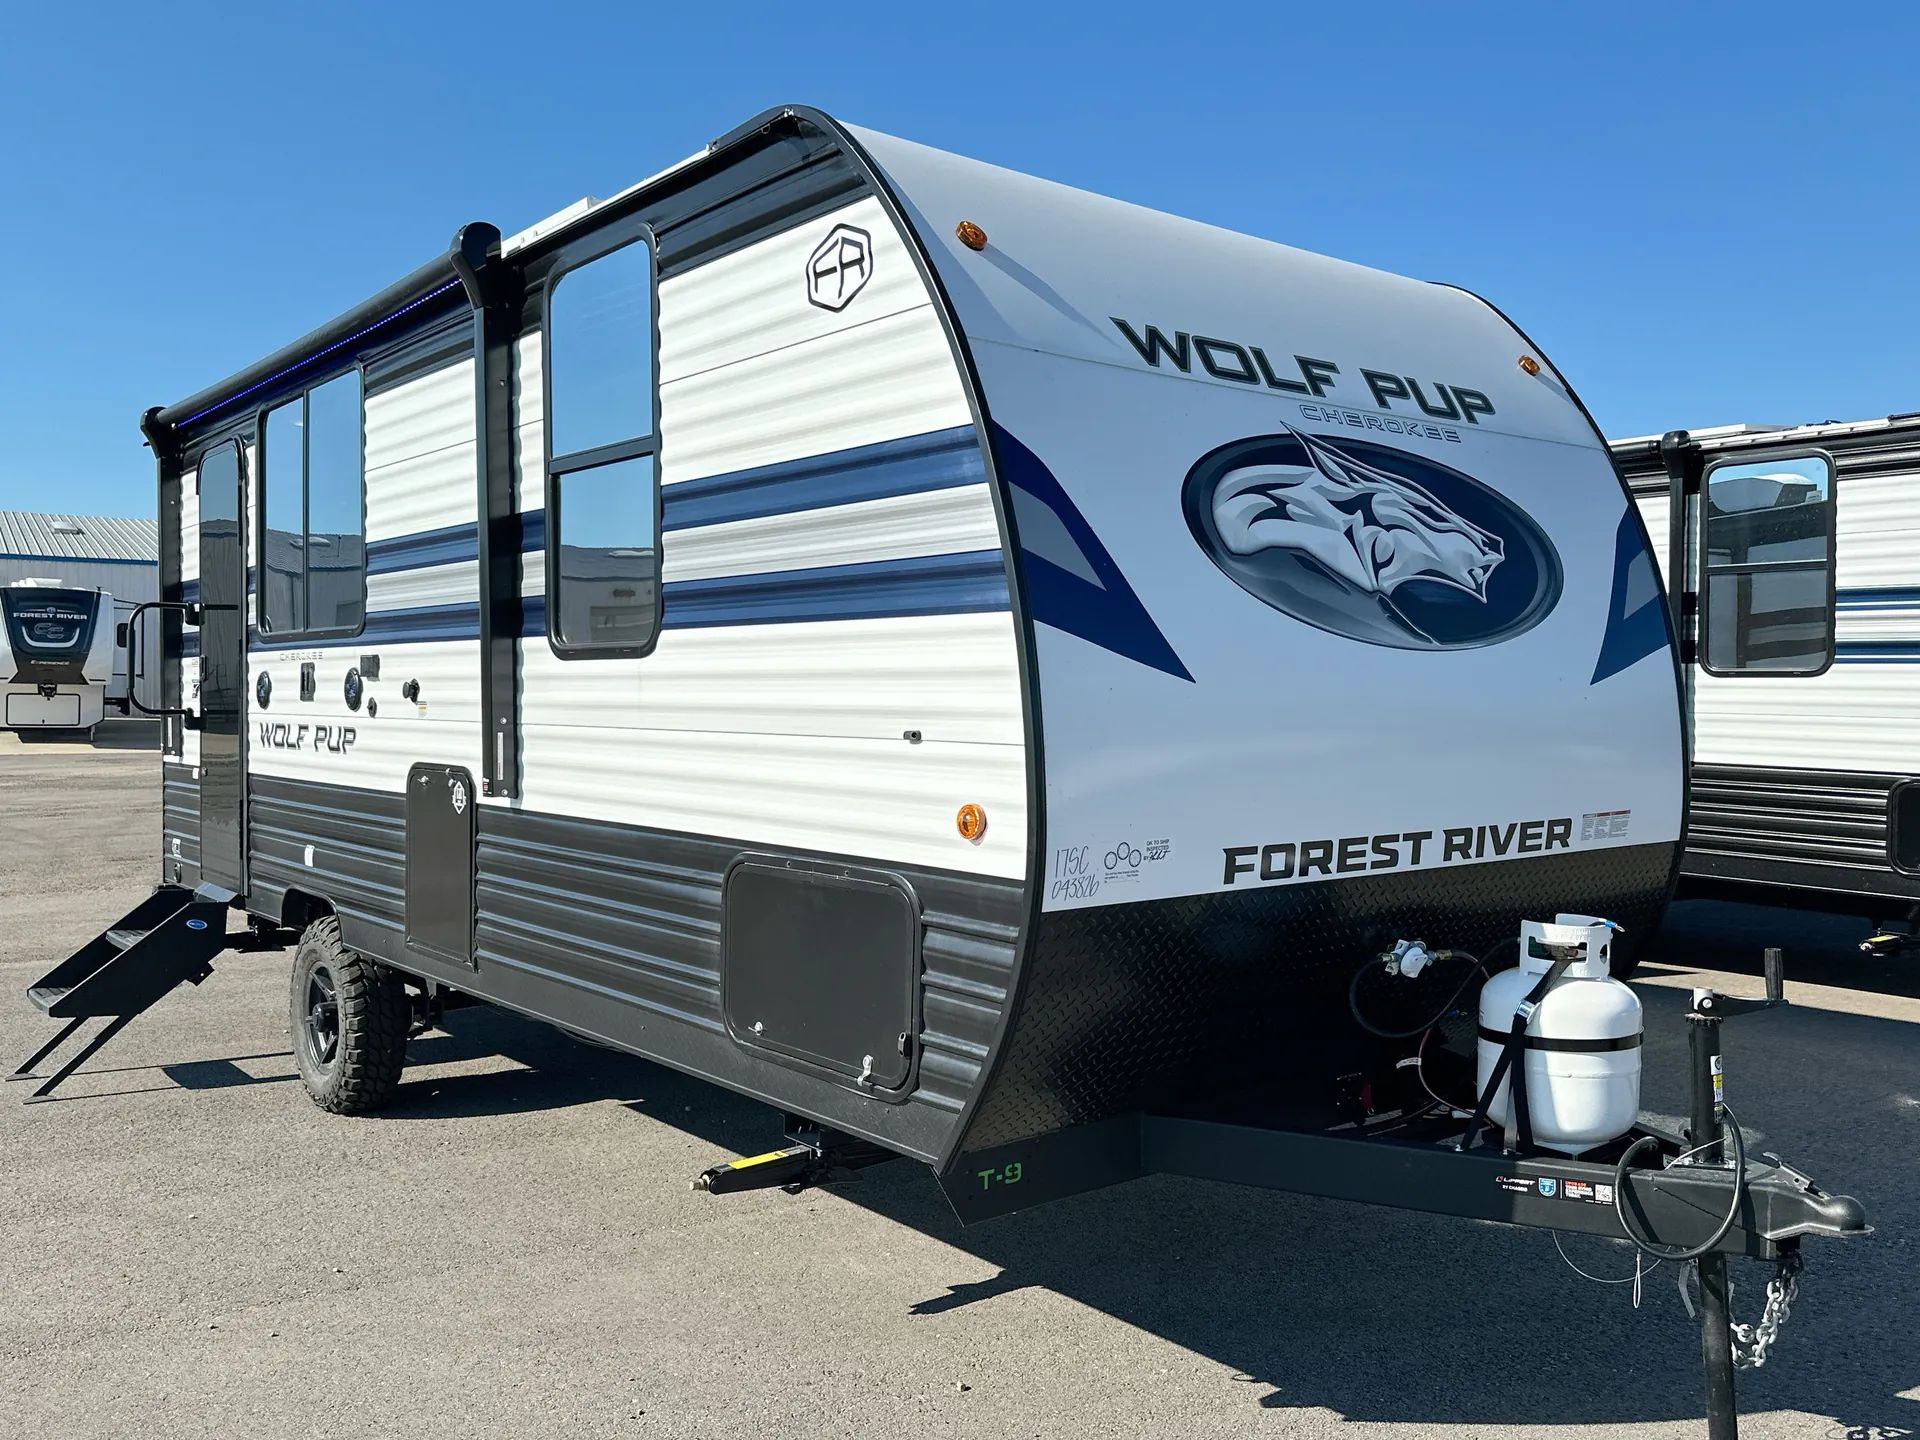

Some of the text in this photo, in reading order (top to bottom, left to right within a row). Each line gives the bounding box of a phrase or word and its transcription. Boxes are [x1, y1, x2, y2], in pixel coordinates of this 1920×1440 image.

[1109, 316, 1496, 425] WOLF PUP
[1299, 404, 1462, 444] CHEROKEE
[260, 722, 357, 755] WOLF PUP
[1222, 830, 1433, 885] FOREST
[1442, 817, 1573, 862] RIVER
[978, 1162, 1022, 1191] T-9
